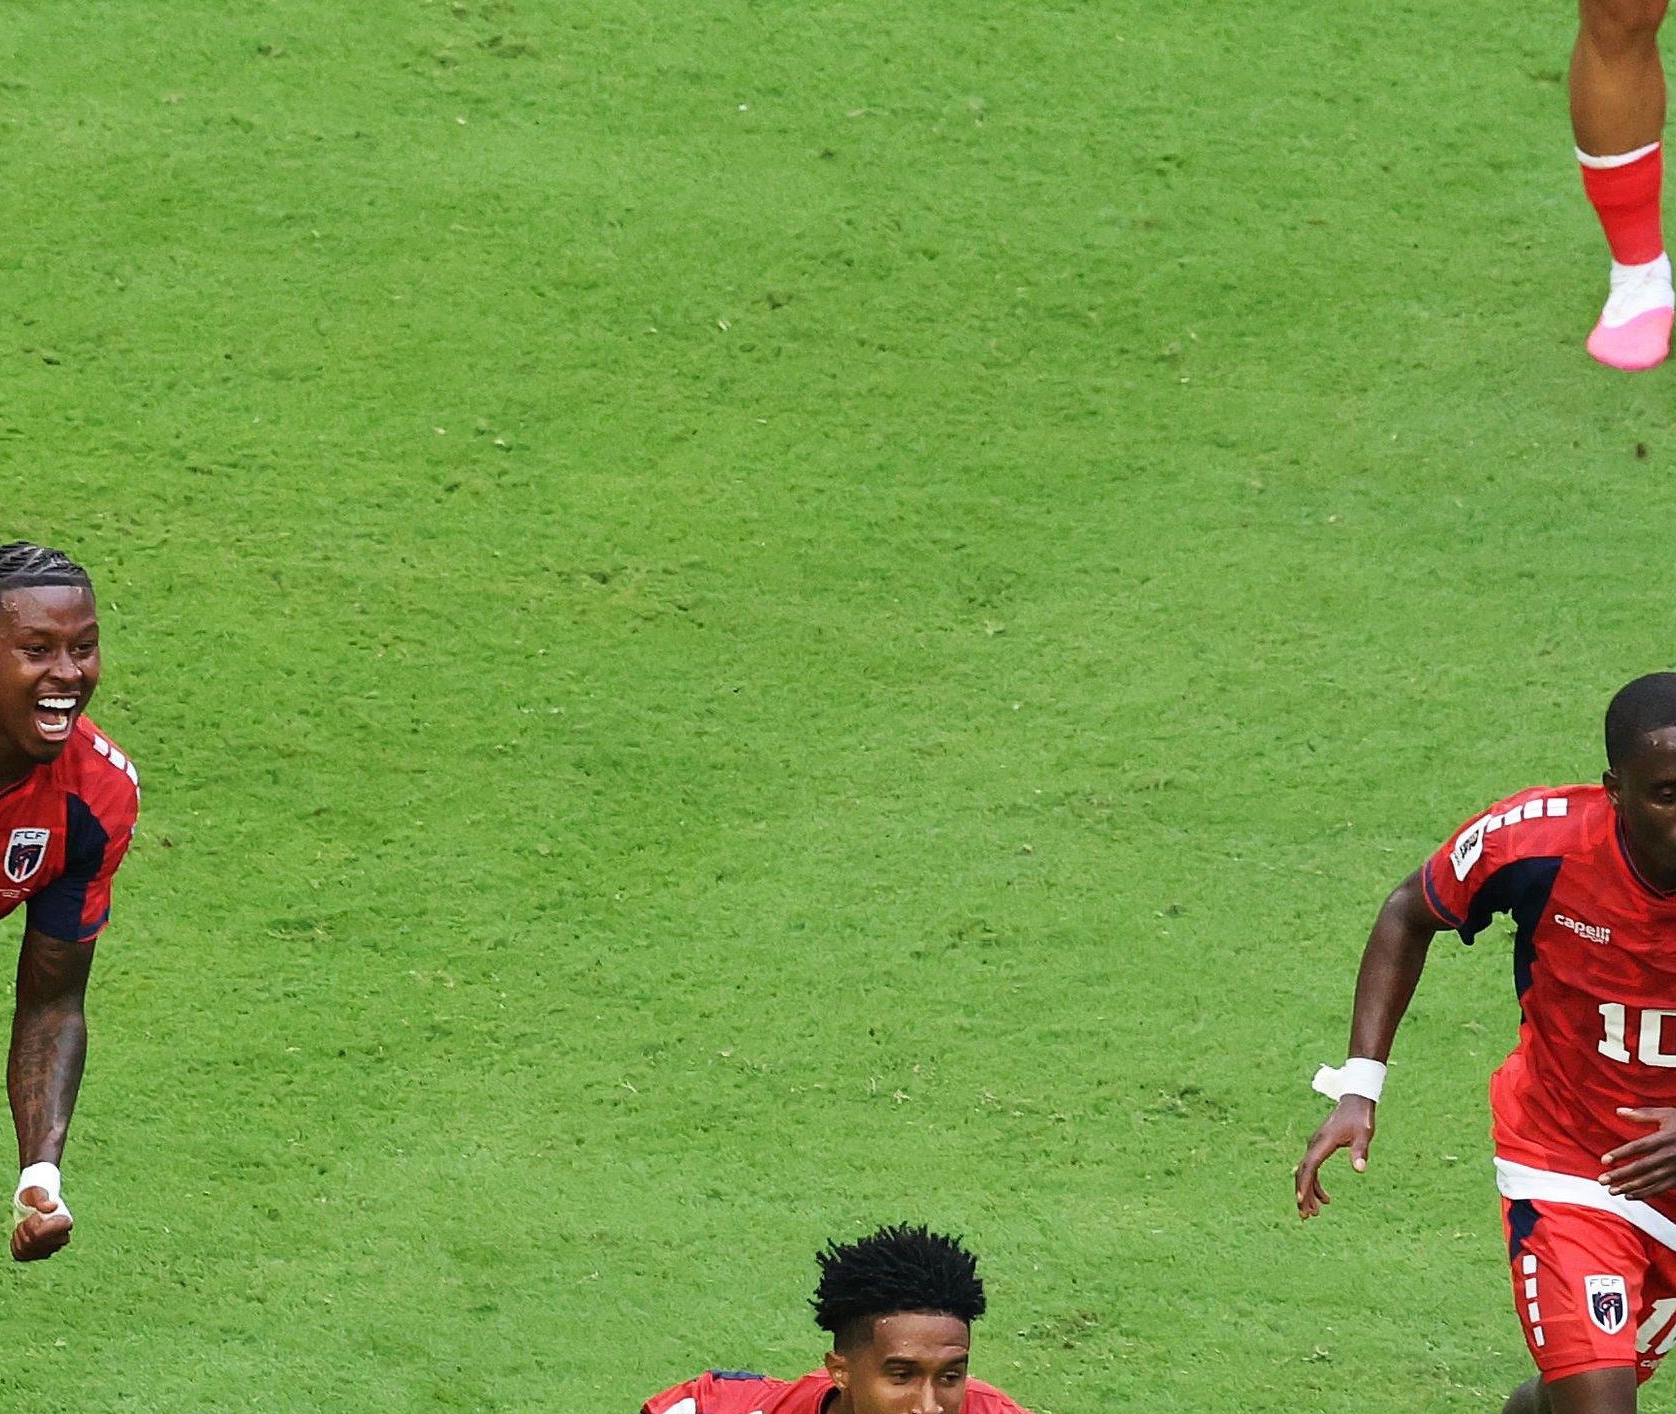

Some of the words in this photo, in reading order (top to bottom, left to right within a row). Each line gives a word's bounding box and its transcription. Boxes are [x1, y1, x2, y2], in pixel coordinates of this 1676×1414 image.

[13, 830, 47, 841] FCF
[1554, 914, 1611, 942] capelli
[1589, 1277, 1621, 1288] FCF
